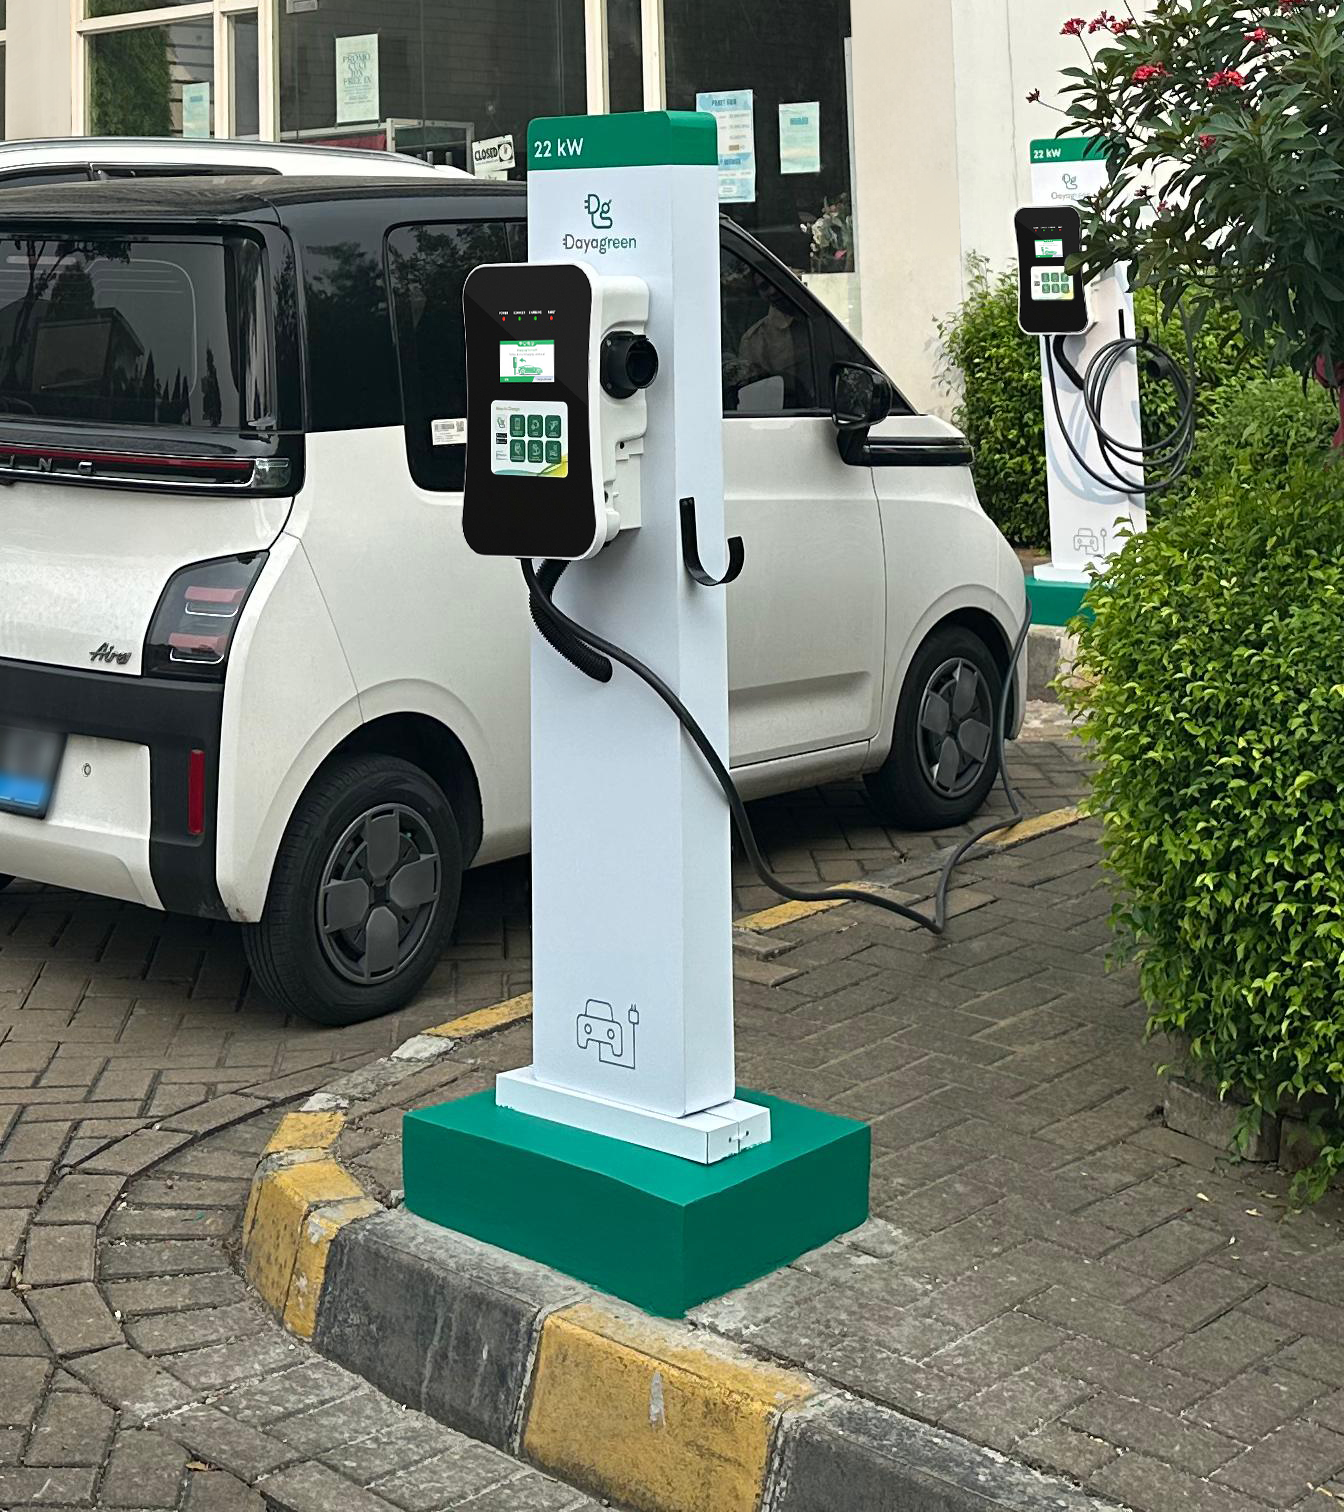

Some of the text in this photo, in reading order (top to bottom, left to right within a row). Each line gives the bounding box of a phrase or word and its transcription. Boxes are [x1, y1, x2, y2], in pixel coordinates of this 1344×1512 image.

[475, 147, 498, 161] CLOSED
[534, 137, 584, 158] 22 kW
[1033, 148, 1062, 159] 22 kW
[562, 233, 637, 255] Dayagreen
